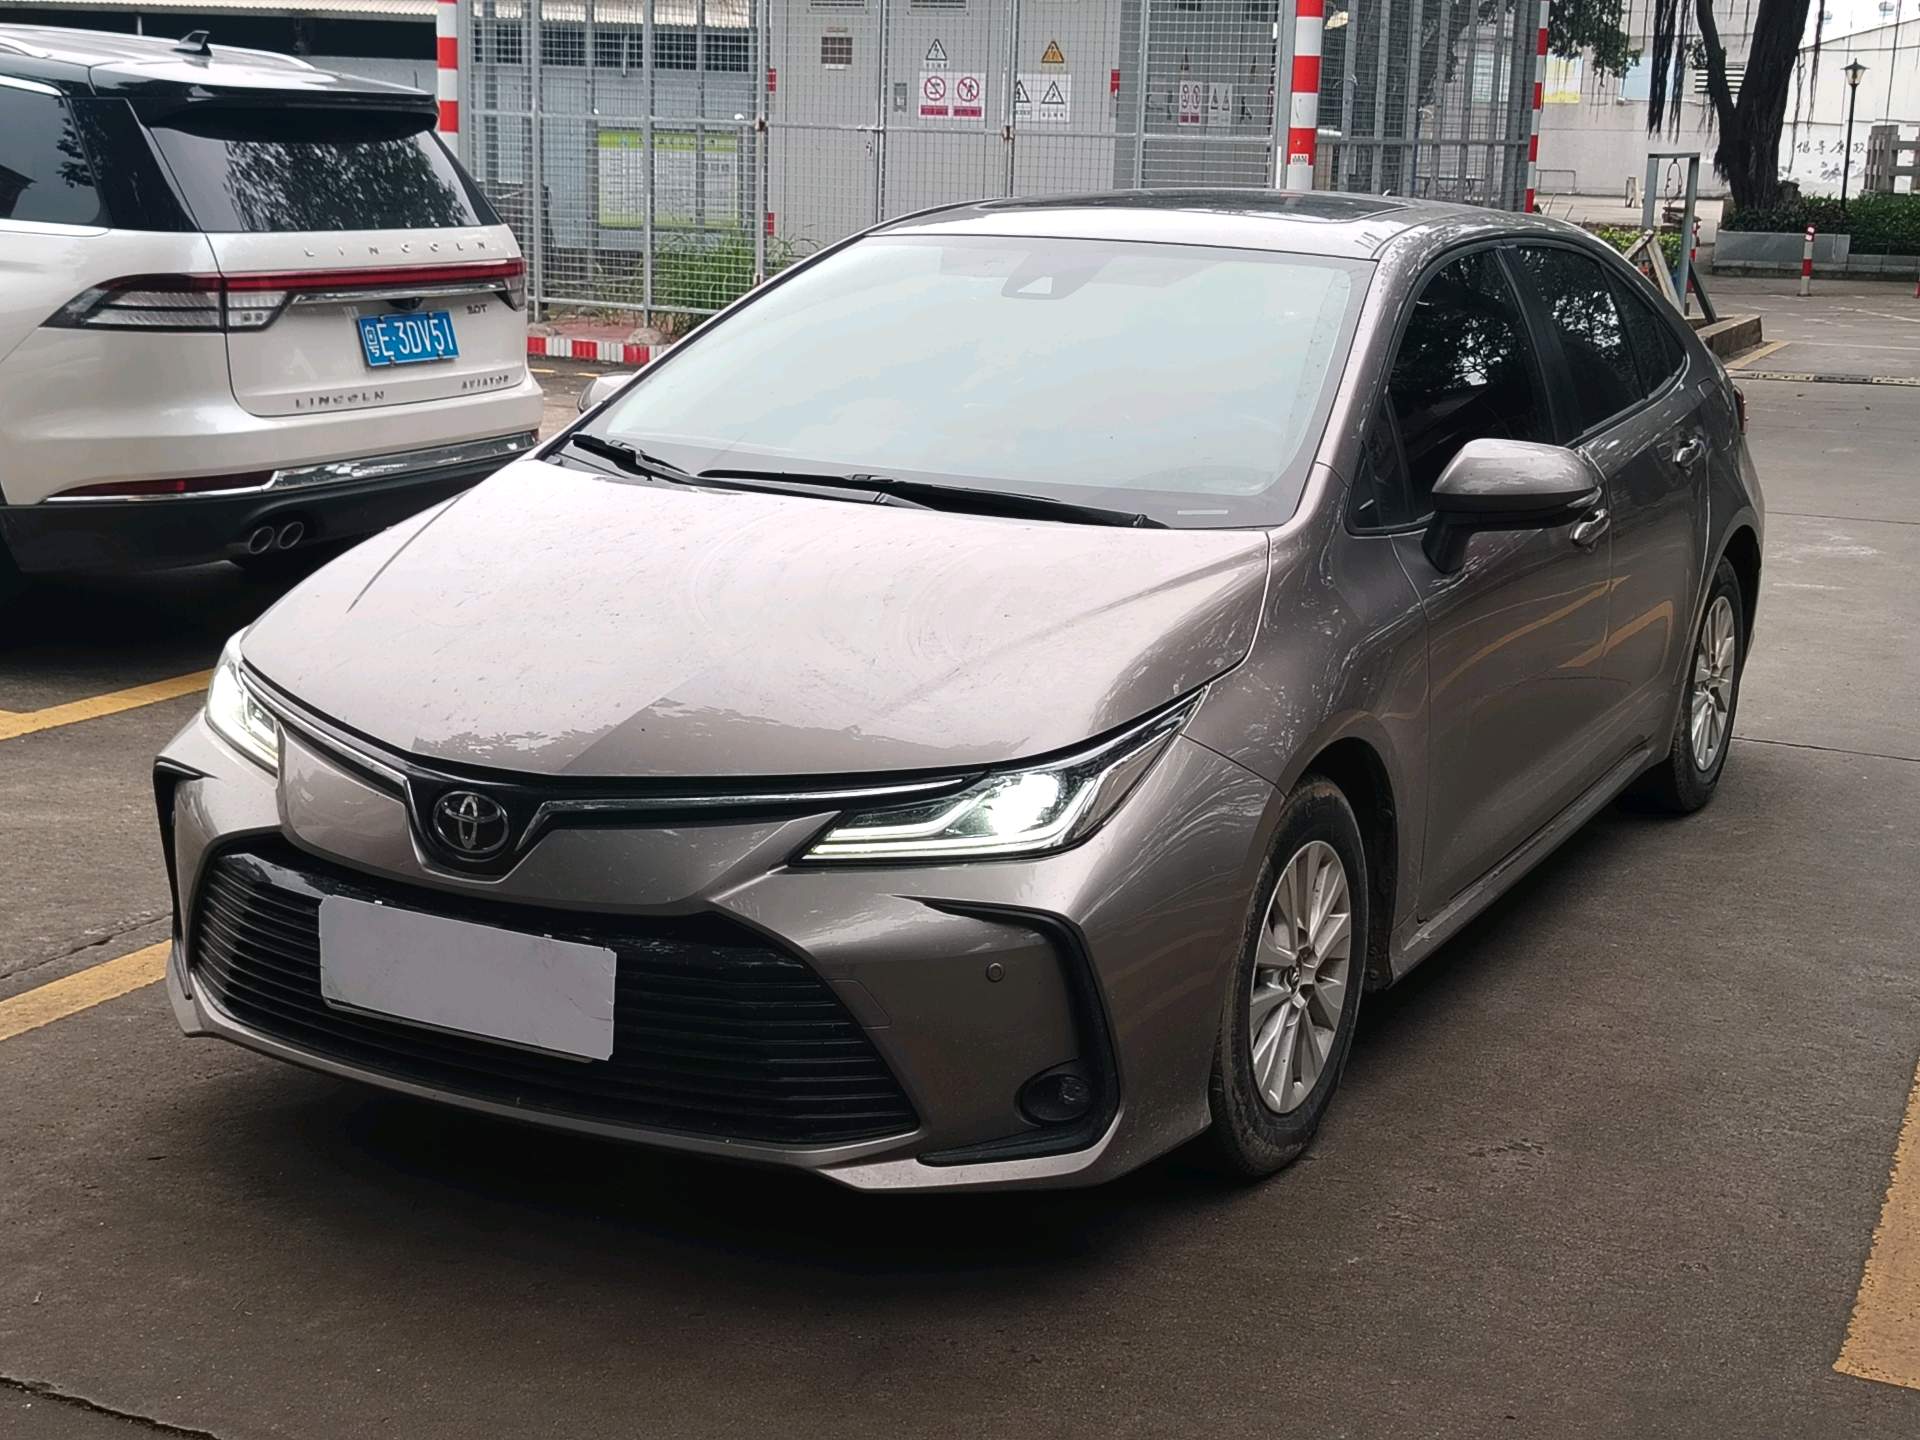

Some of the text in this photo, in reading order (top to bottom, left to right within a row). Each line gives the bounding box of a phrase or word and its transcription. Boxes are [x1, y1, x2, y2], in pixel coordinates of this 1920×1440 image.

[305, 242, 486, 257] LINCOLN
[461, 375, 509, 389] AVIATOR
[295, 391, 386, 409] LINCOLN
